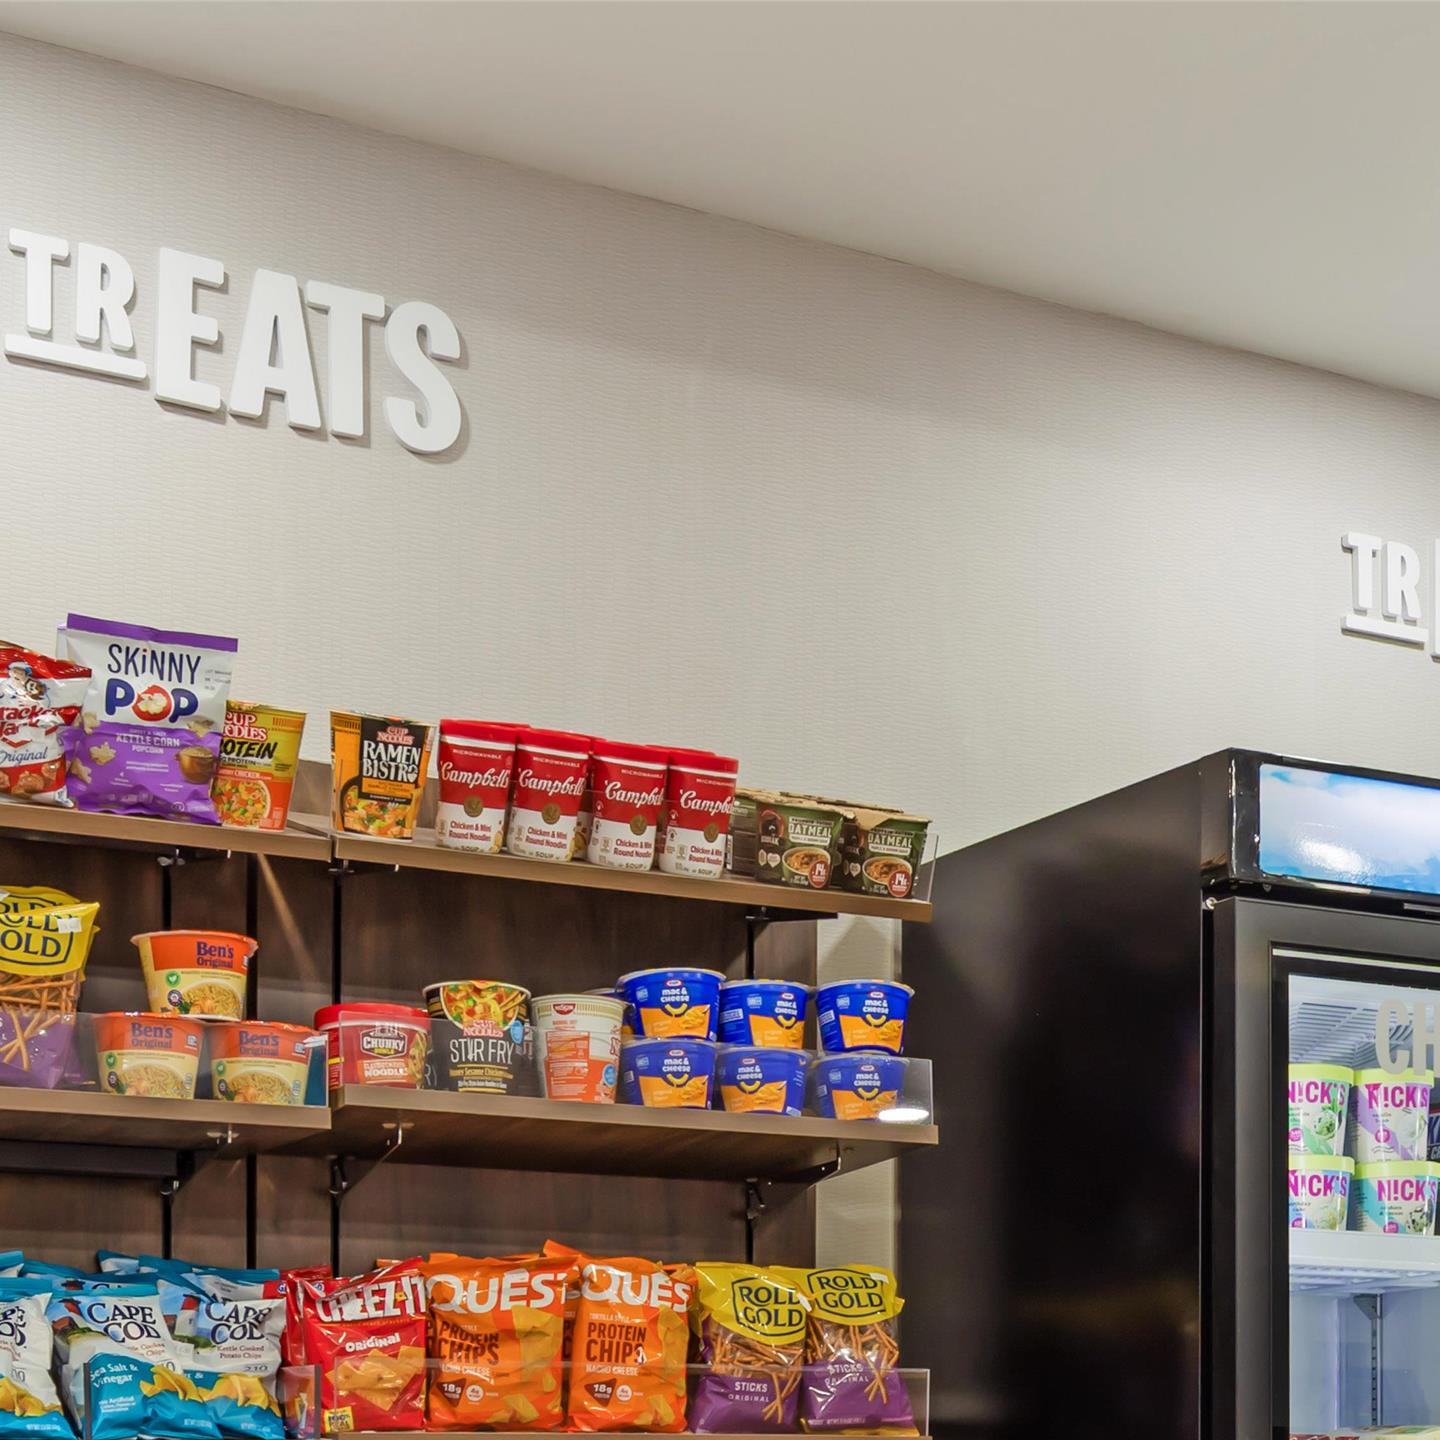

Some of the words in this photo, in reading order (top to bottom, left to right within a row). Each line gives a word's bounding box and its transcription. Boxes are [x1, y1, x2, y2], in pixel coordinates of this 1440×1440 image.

[5, 226, 465, 454] TREATS
[105, 678, 198, 723] POP
[363, 740, 420, 765] RAMEN
[363, 759, 418, 782] BISTRO
[788, 824, 832, 839] OATMEAL
[197, 942, 234, 959] Ben's
[817, 1276, 880, 1291] ROLD
[821, 1292, 883, 1309] GOLD
[87, 1303, 156, 1324] CAPE
[739, 1307, 803, 1327] GOLD
[587, 1322, 646, 1343] PROTEIN
[439, 1341, 499, 1365] CHIPS
[586, 1339, 645, 1363] CHIPS
